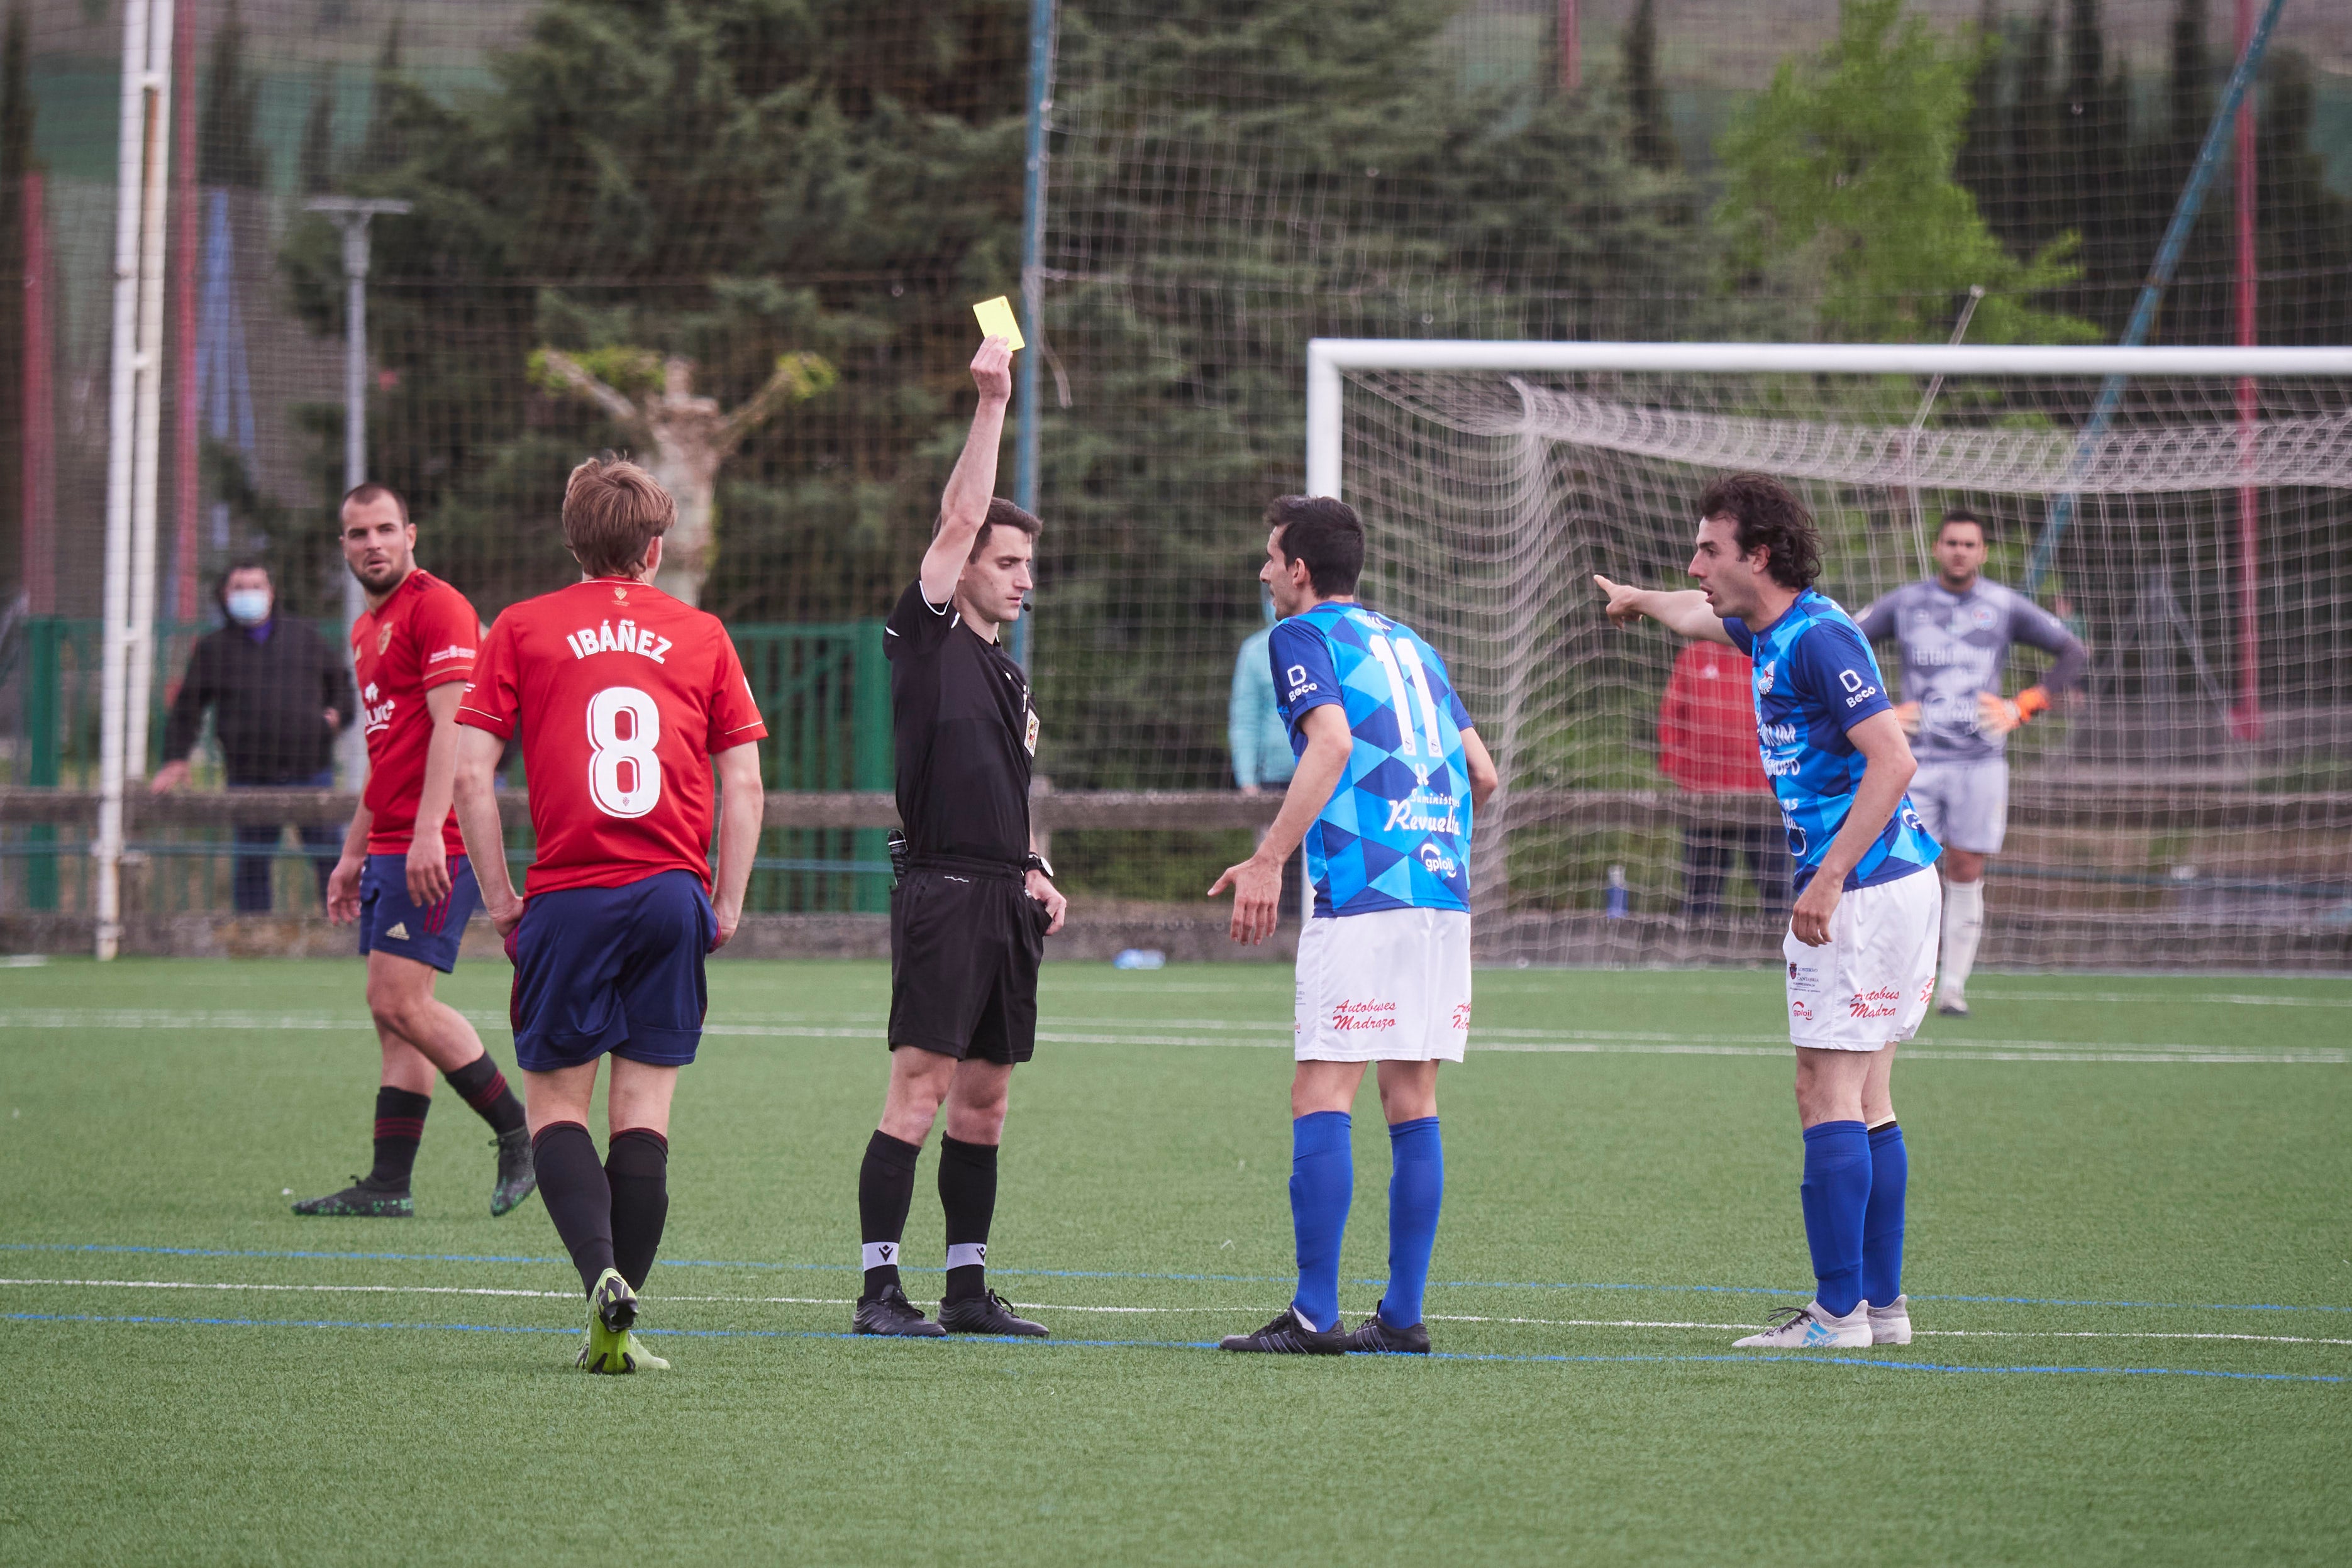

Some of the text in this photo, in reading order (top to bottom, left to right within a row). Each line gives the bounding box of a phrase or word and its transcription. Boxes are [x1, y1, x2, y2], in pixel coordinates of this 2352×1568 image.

[567, 619, 672, 664] IBÁÑEZ
[1288, 683, 1317, 702] Beco
[1369, 634, 1445, 758] 11
[1846, 686, 1876, 708] Beco
[587, 687, 662, 819] 8
[1384, 799, 1460, 836] Revuelta
[1333, 998, 1397, 1013] Autobuses
[1333, 1014, 1396, 1032] Madrazo
